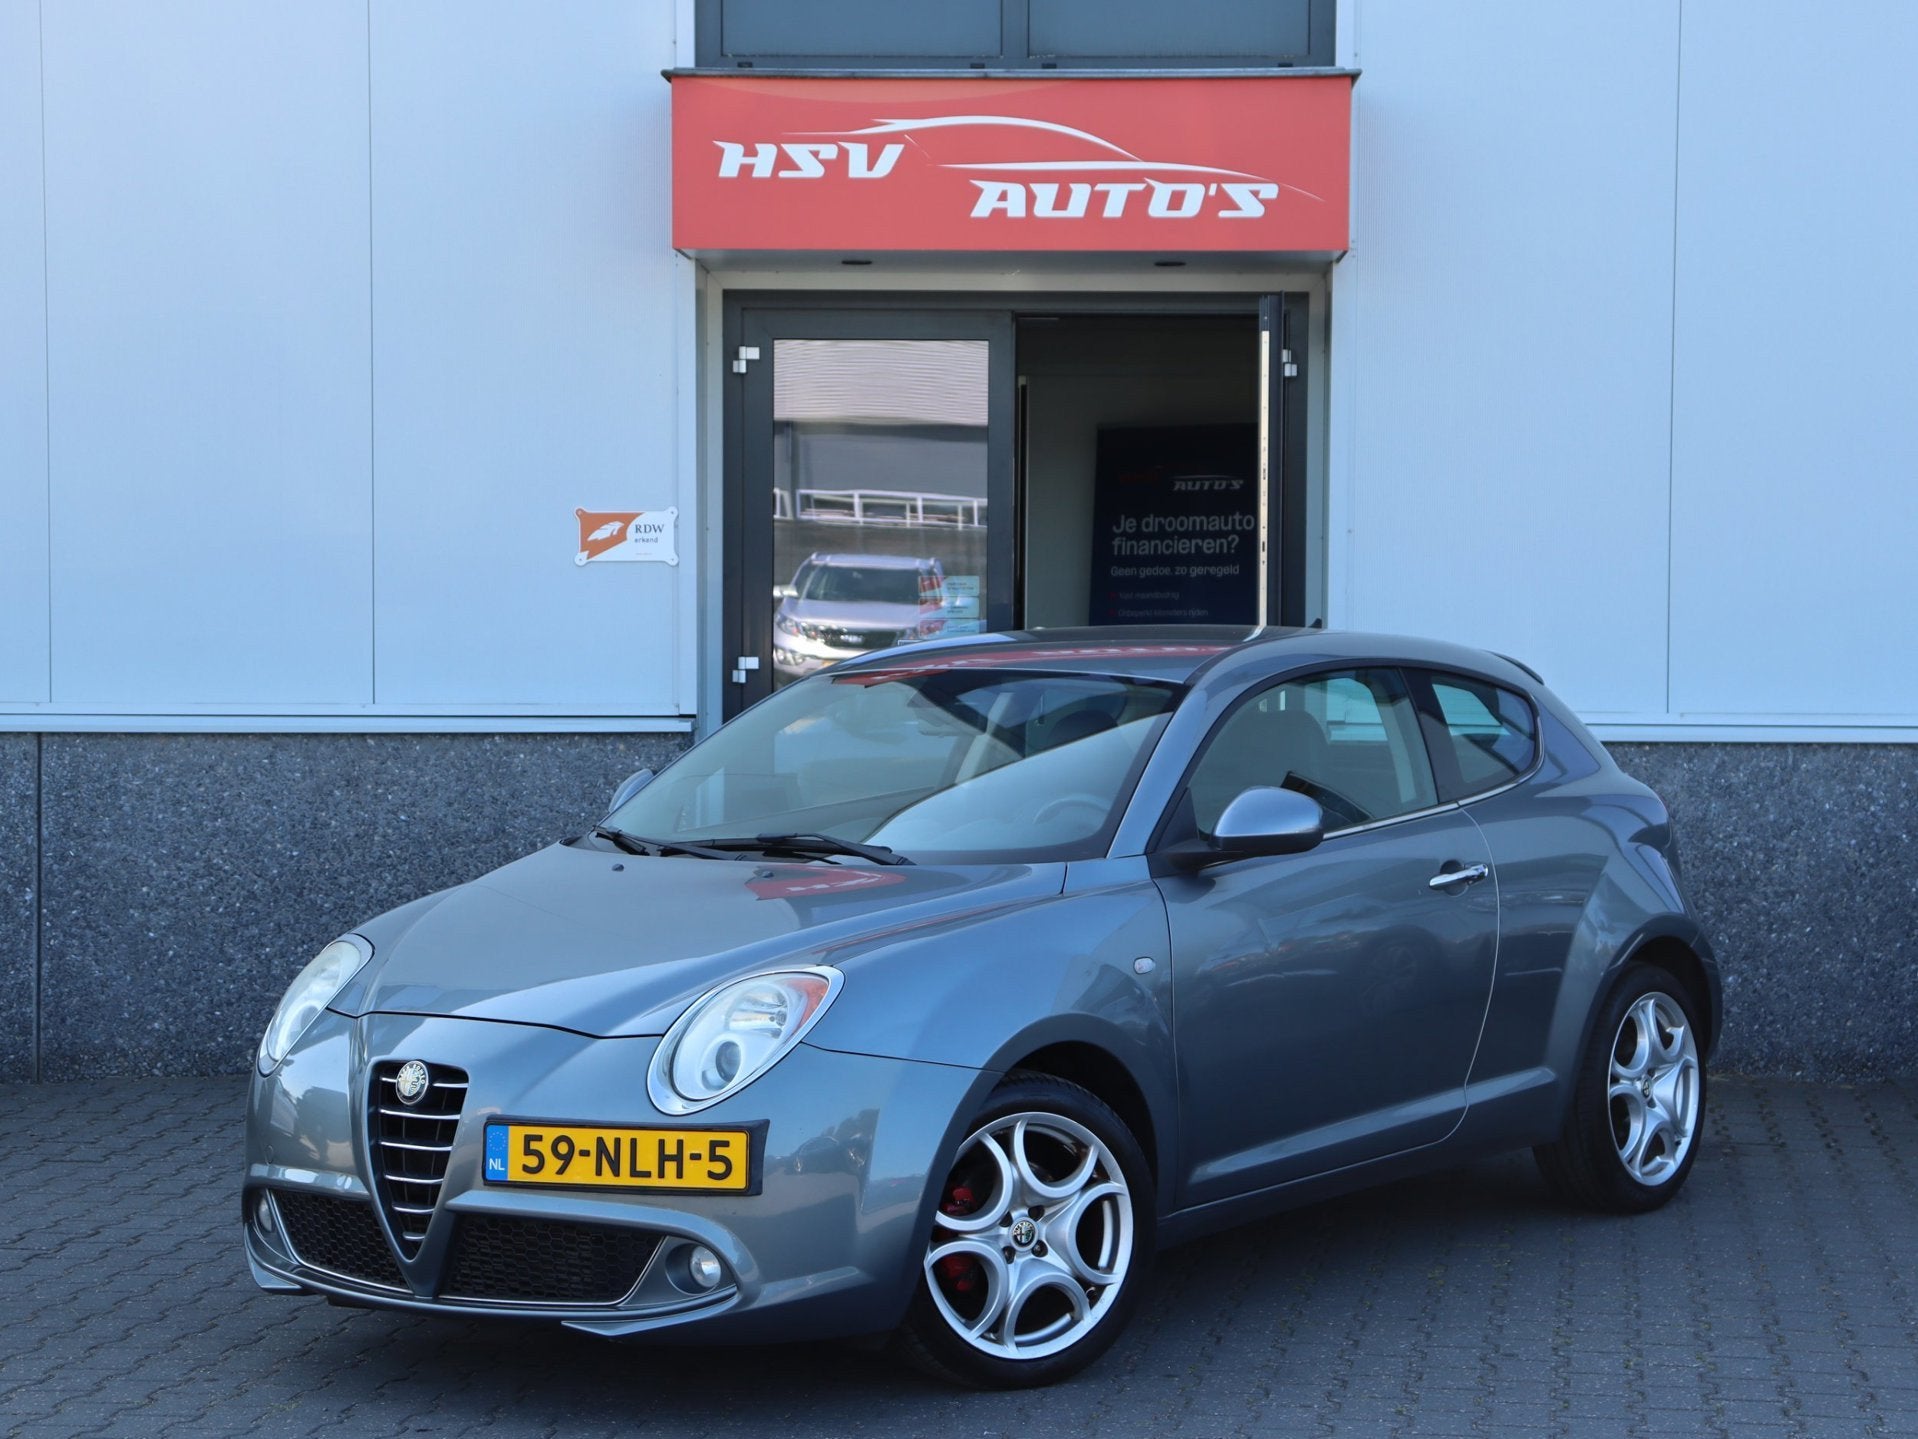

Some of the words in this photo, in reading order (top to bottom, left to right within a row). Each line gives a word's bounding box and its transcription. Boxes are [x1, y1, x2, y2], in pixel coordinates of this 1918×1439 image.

[713, 140, 905, 179] HSV
[970, 177, 1279, 218] AUTO'S
[1172, 479, 1244, 491] AUTO'S
[635, 524, 665, 534] RDW
[1112, 514, 1137, 533] Je
[1141, 511, 1255, 532] droomauto
[1112, 534, 1240, 556] financieren?
[1110, 566, 1137, 577] Geen
[1175, 565, 1188, 575] zo
[1189, 563, 1240, 577] geregeld
[489, 1158, 505, 1171] NL
[521, 1134, 733, 1181] 59-NLH-5
